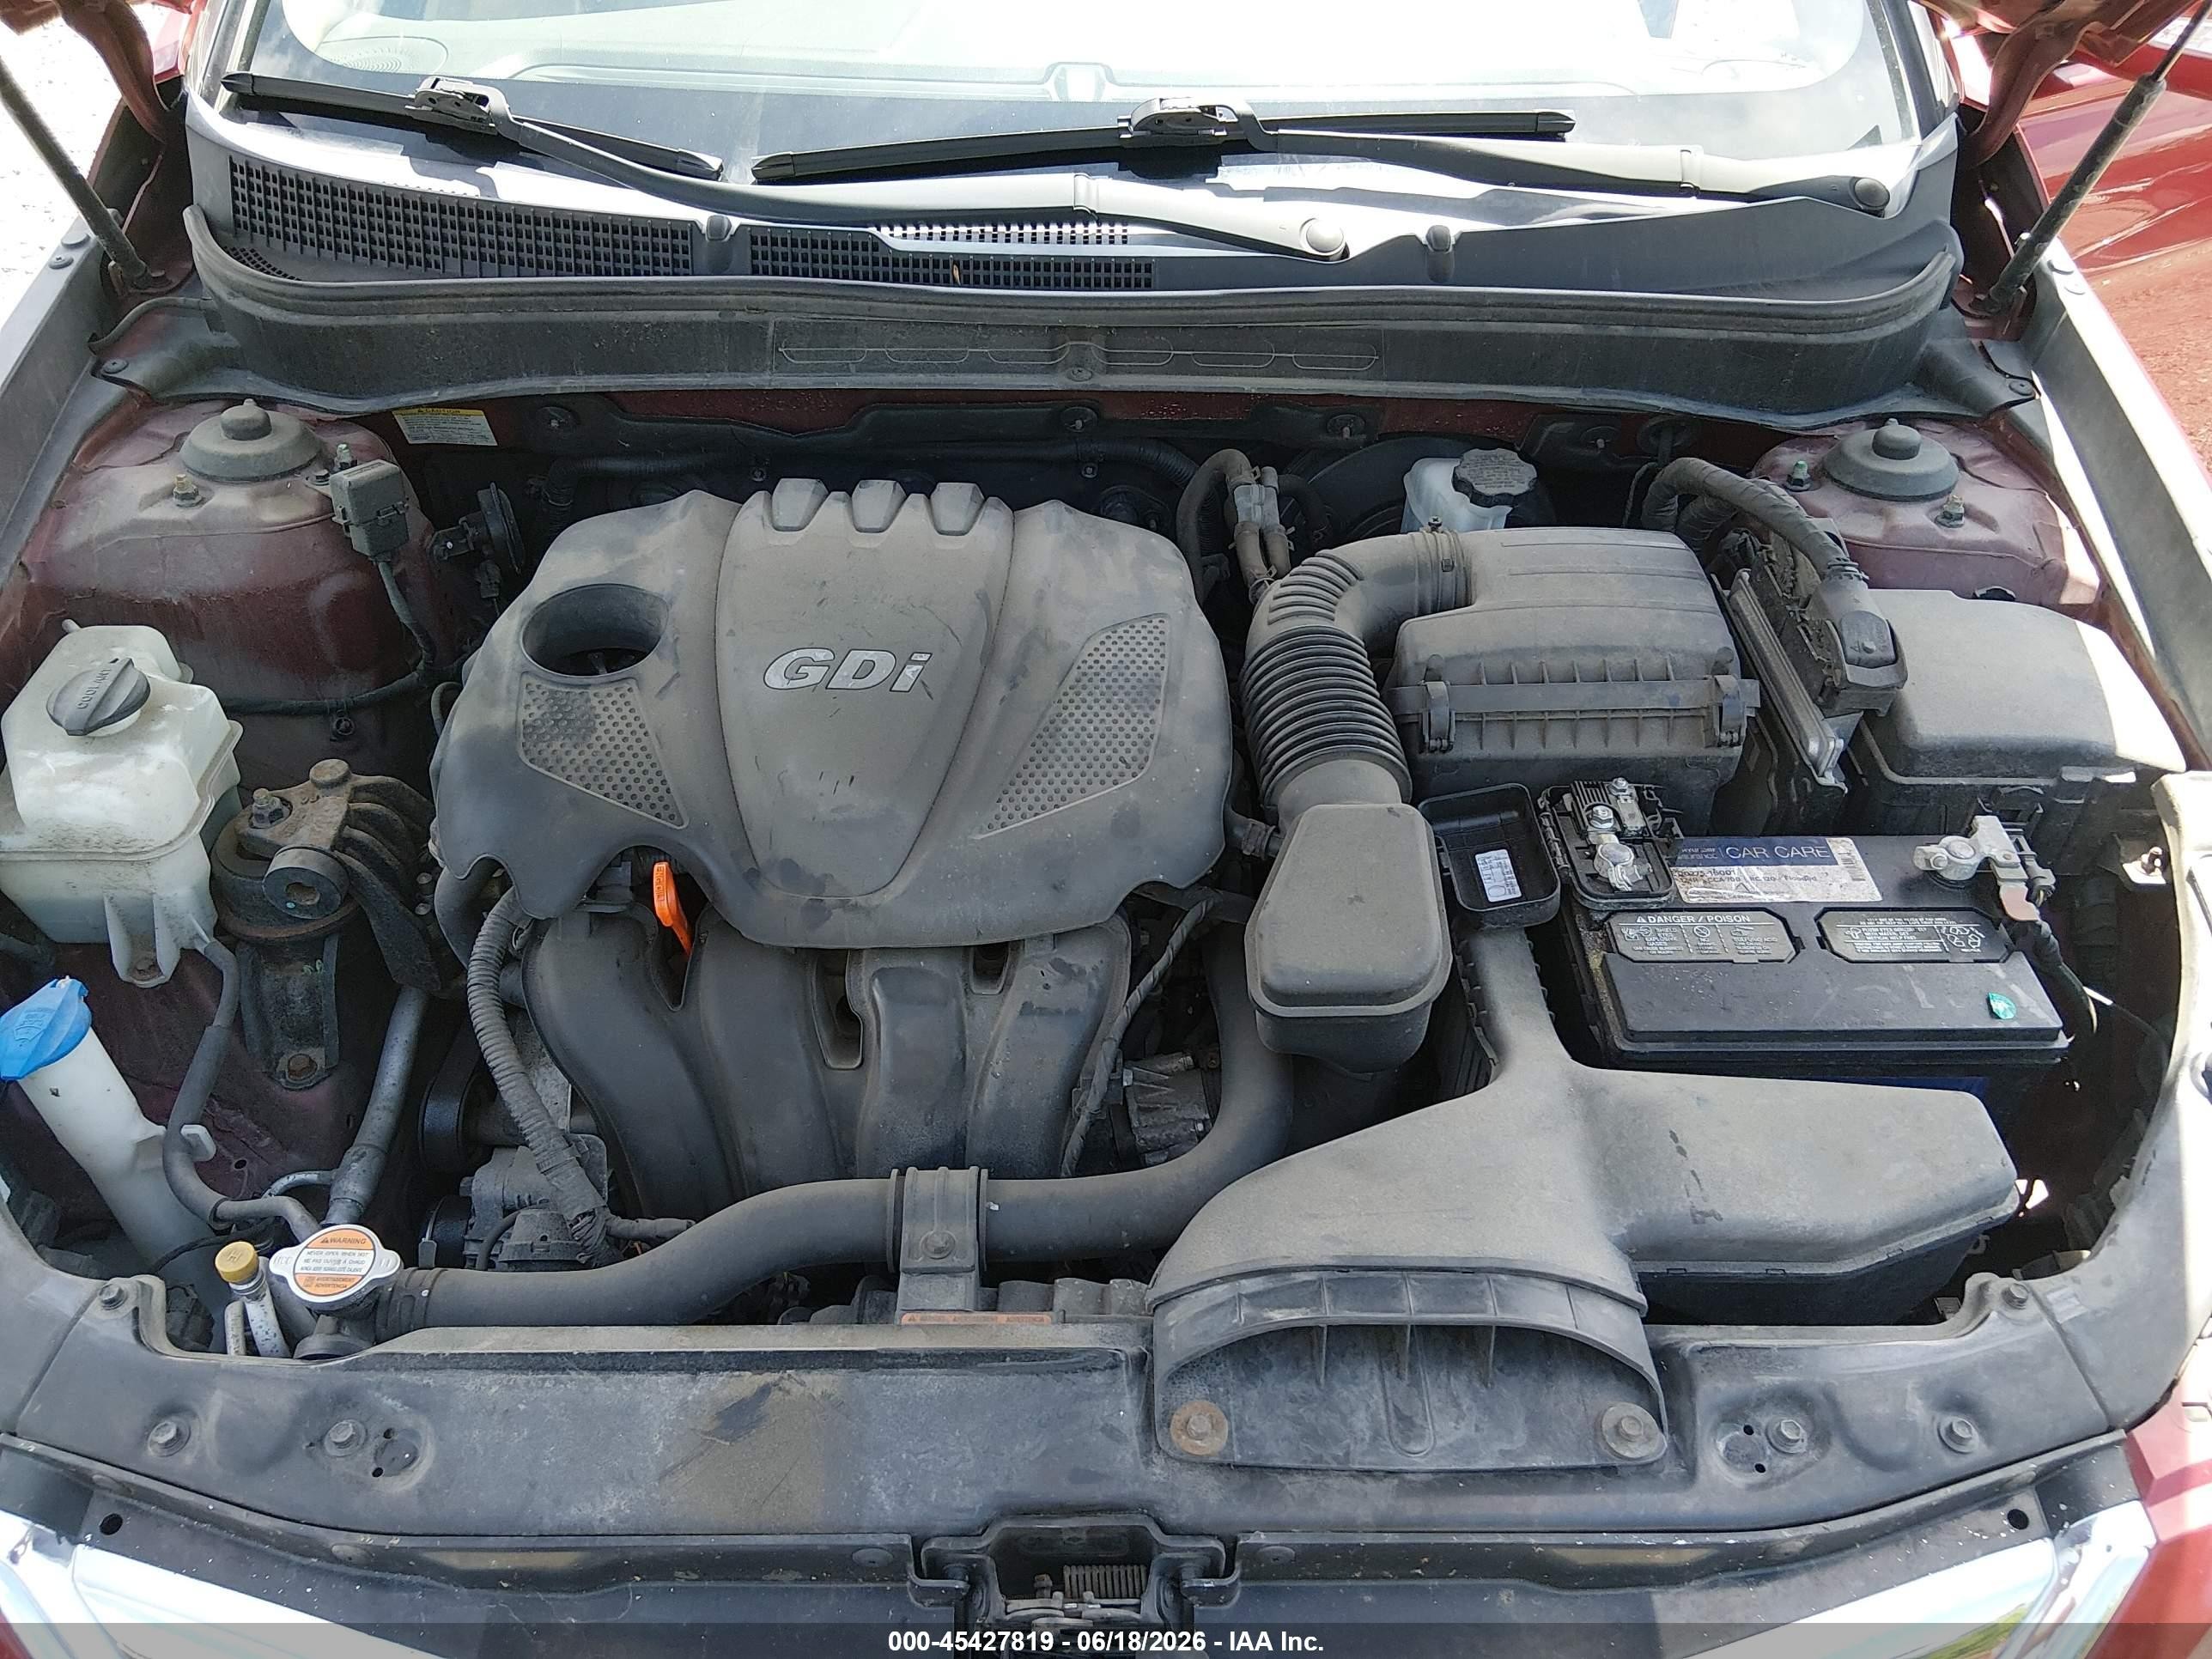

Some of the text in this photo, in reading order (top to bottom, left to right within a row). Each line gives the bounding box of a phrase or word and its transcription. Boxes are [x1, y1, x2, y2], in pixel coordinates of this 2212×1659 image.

[763, 647, 933, 693] GDi
[77, 668, 111, 709] COOLANT
[1725, 846, 1769, 860] CAR
[1774, 846, 1831, 859] CARE
[1647, 915, 1695, 923] DANGER
[1706, 915, 1751, 924] POISON
